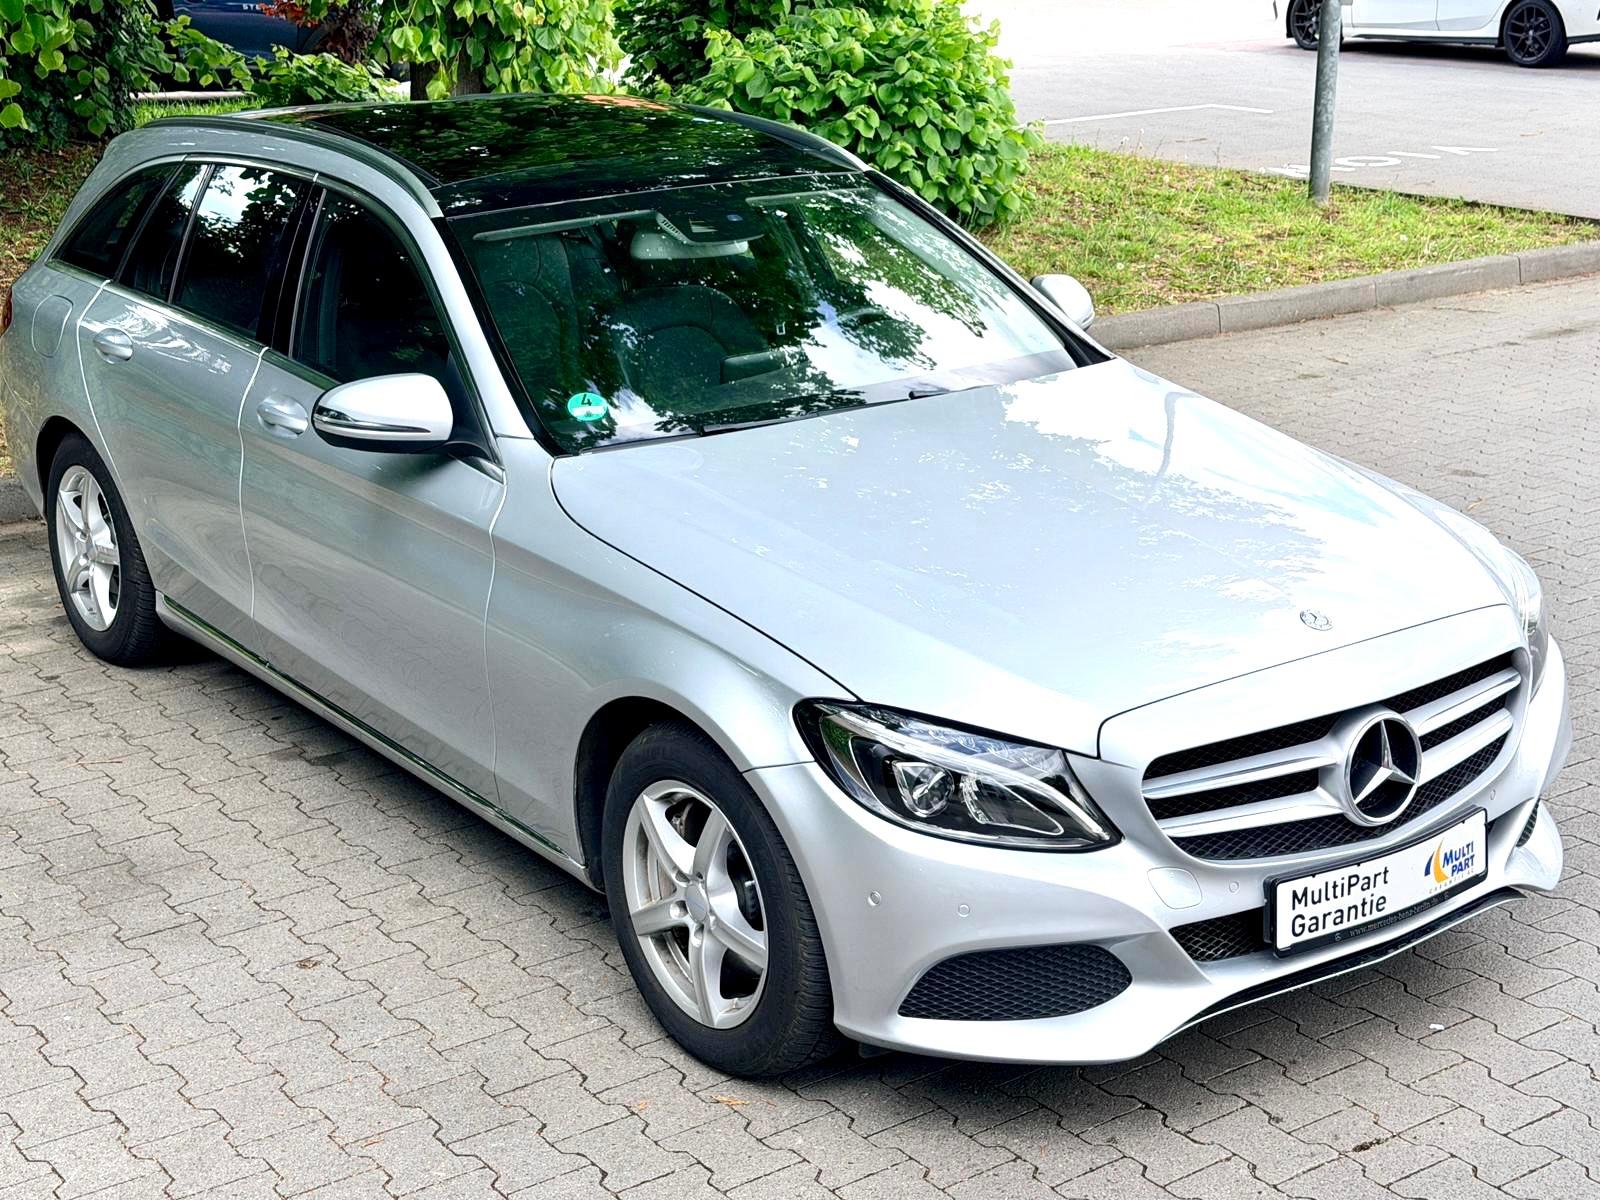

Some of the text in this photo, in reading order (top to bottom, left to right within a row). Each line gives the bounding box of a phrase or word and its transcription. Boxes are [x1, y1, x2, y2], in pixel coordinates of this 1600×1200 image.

[581, 393, 592, 406] 4
[1442, 840, 1474, 869] MULTI
[1450, 853, 1475, 877] PART
[1291, 866, 1390, 911] MultiPart
[1291, 893, 1388, 938] Garantie
